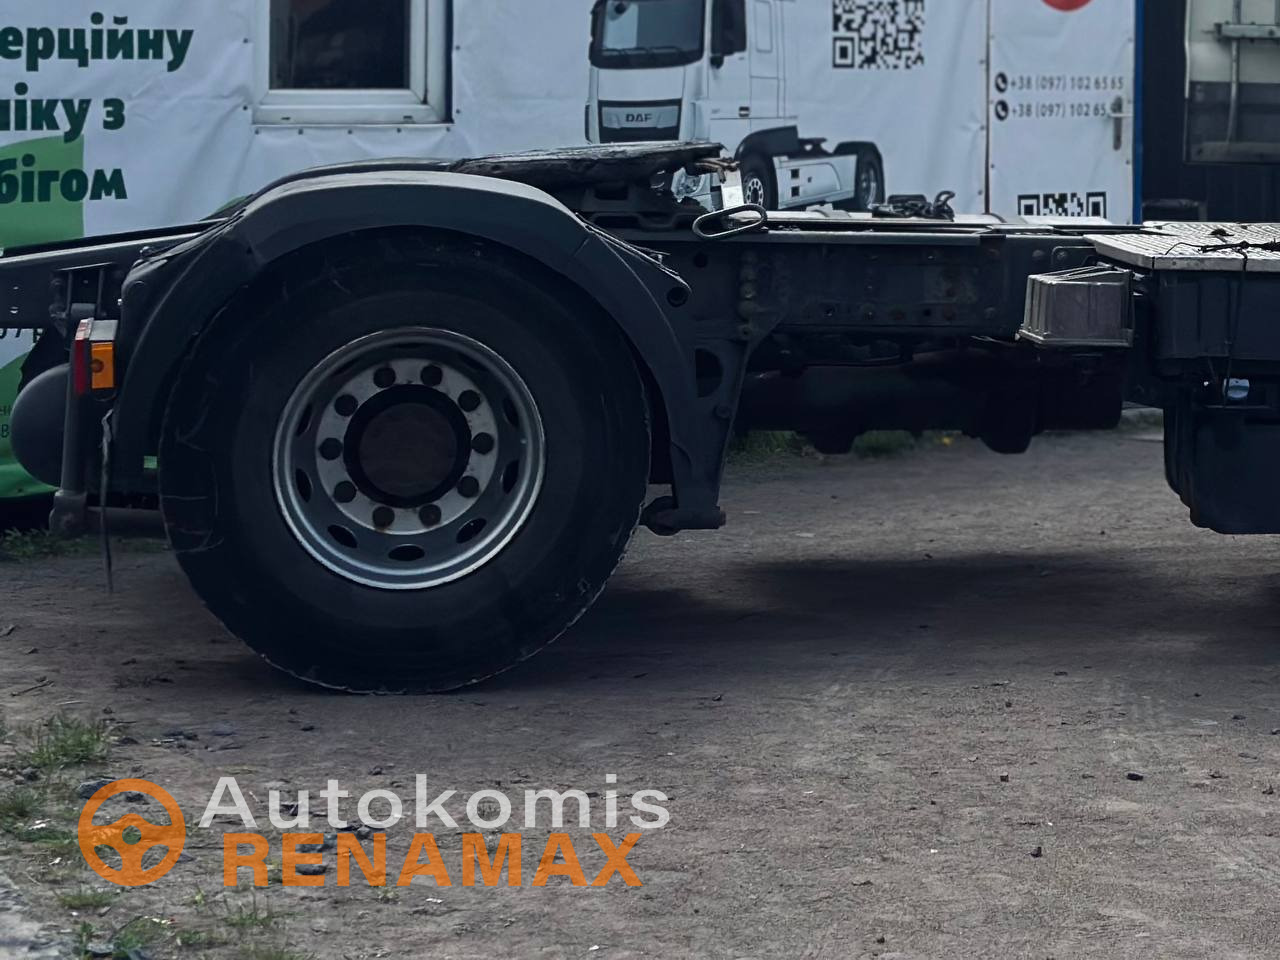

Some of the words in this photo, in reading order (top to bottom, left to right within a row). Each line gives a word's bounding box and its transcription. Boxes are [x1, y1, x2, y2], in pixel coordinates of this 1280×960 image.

[0, 12, 194, 72] ерційну
[1011, 75, 1031, 90] +38
[1036, 74, 1066, 91] (097)
[1070, 76, 1090, 90] 102
[625, 113, 652, 123] DAF
[1012, 103, 1032, 117] +38
[1036, 103, 1066, 118] (097)
[1070, 104, 1090, 117] 102
[0, 154, 128, 204] бігом
